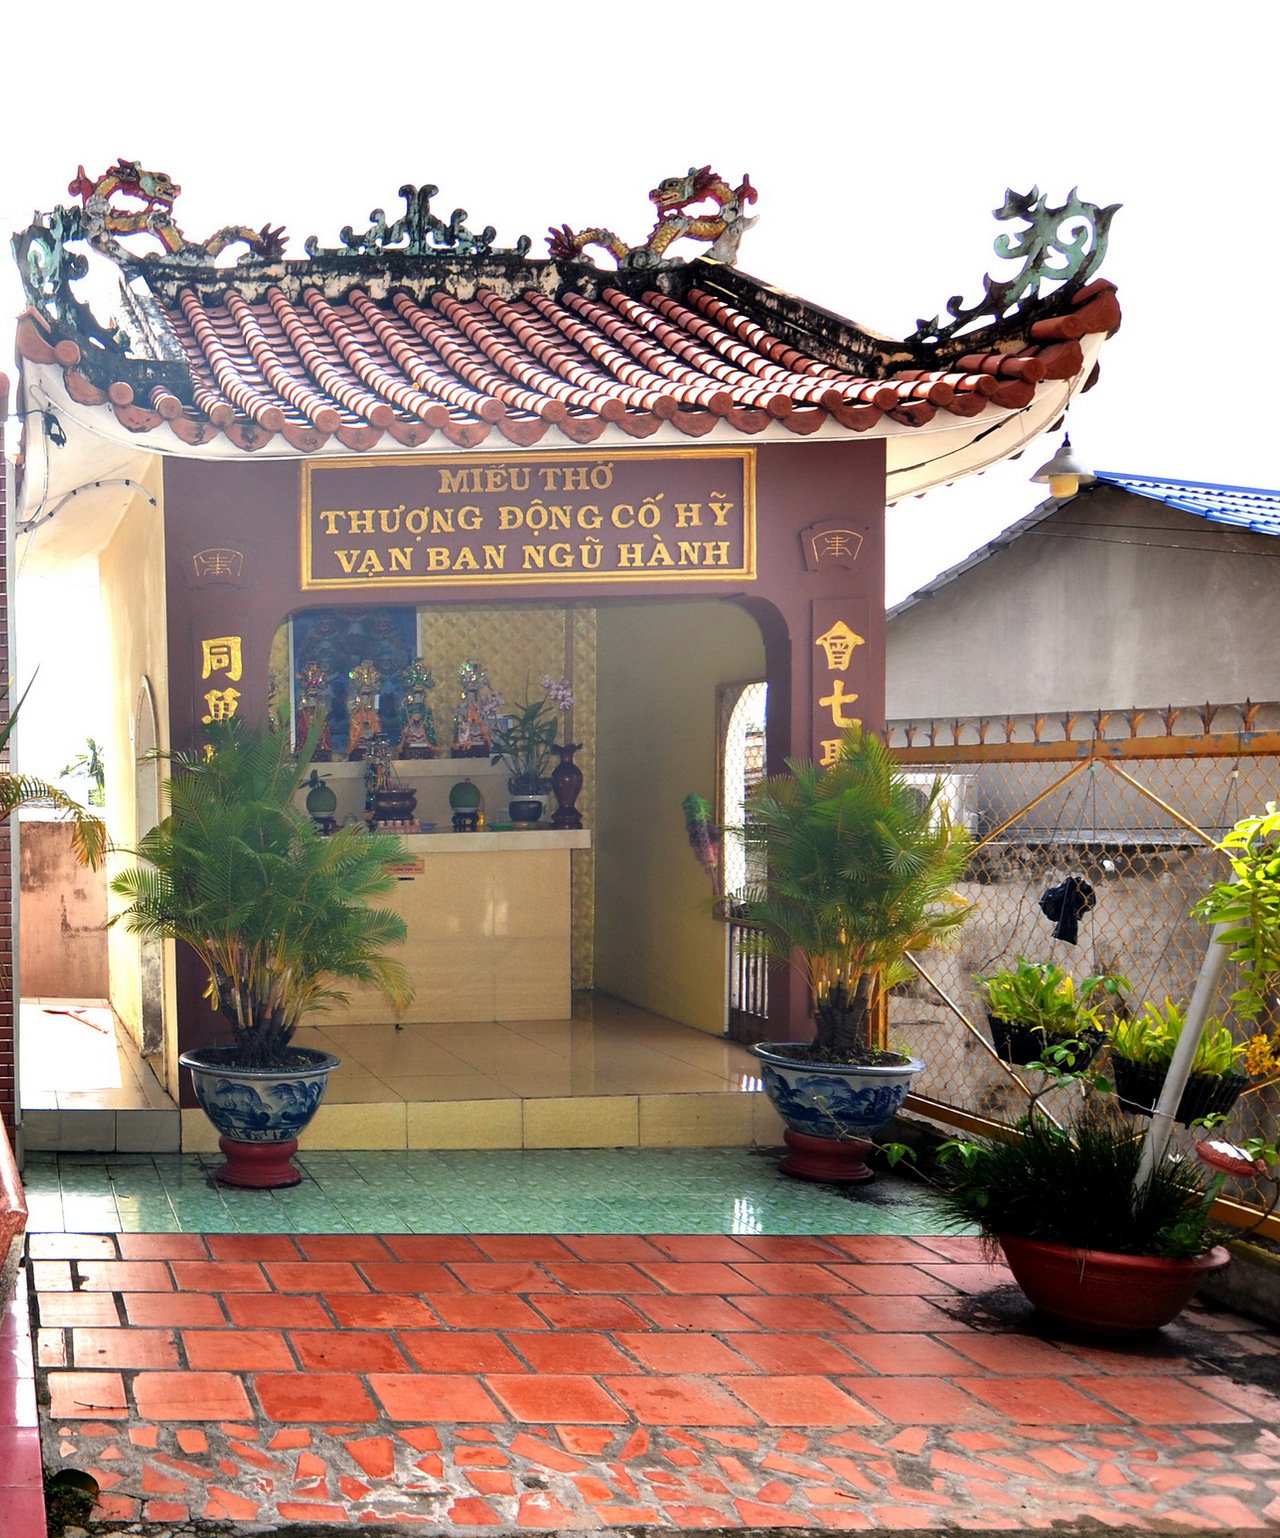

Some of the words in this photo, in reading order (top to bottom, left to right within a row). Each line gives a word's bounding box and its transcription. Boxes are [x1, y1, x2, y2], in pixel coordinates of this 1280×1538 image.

[438, 464, 532, 494] MIẾU
[319, 504, 483, 542] THƯỢNG
[497, 498, 604, 536] ĐỘNG
[611, 492, 665, 529] CỐ
[674, 491, 735, 528] HỸ
[333, 547, 414, 577] VẠN
[426, 544, 507, 571] BAN
[521, 536, 605, 569] NGŨ
[617, 534, 731, 567] HÀNH
